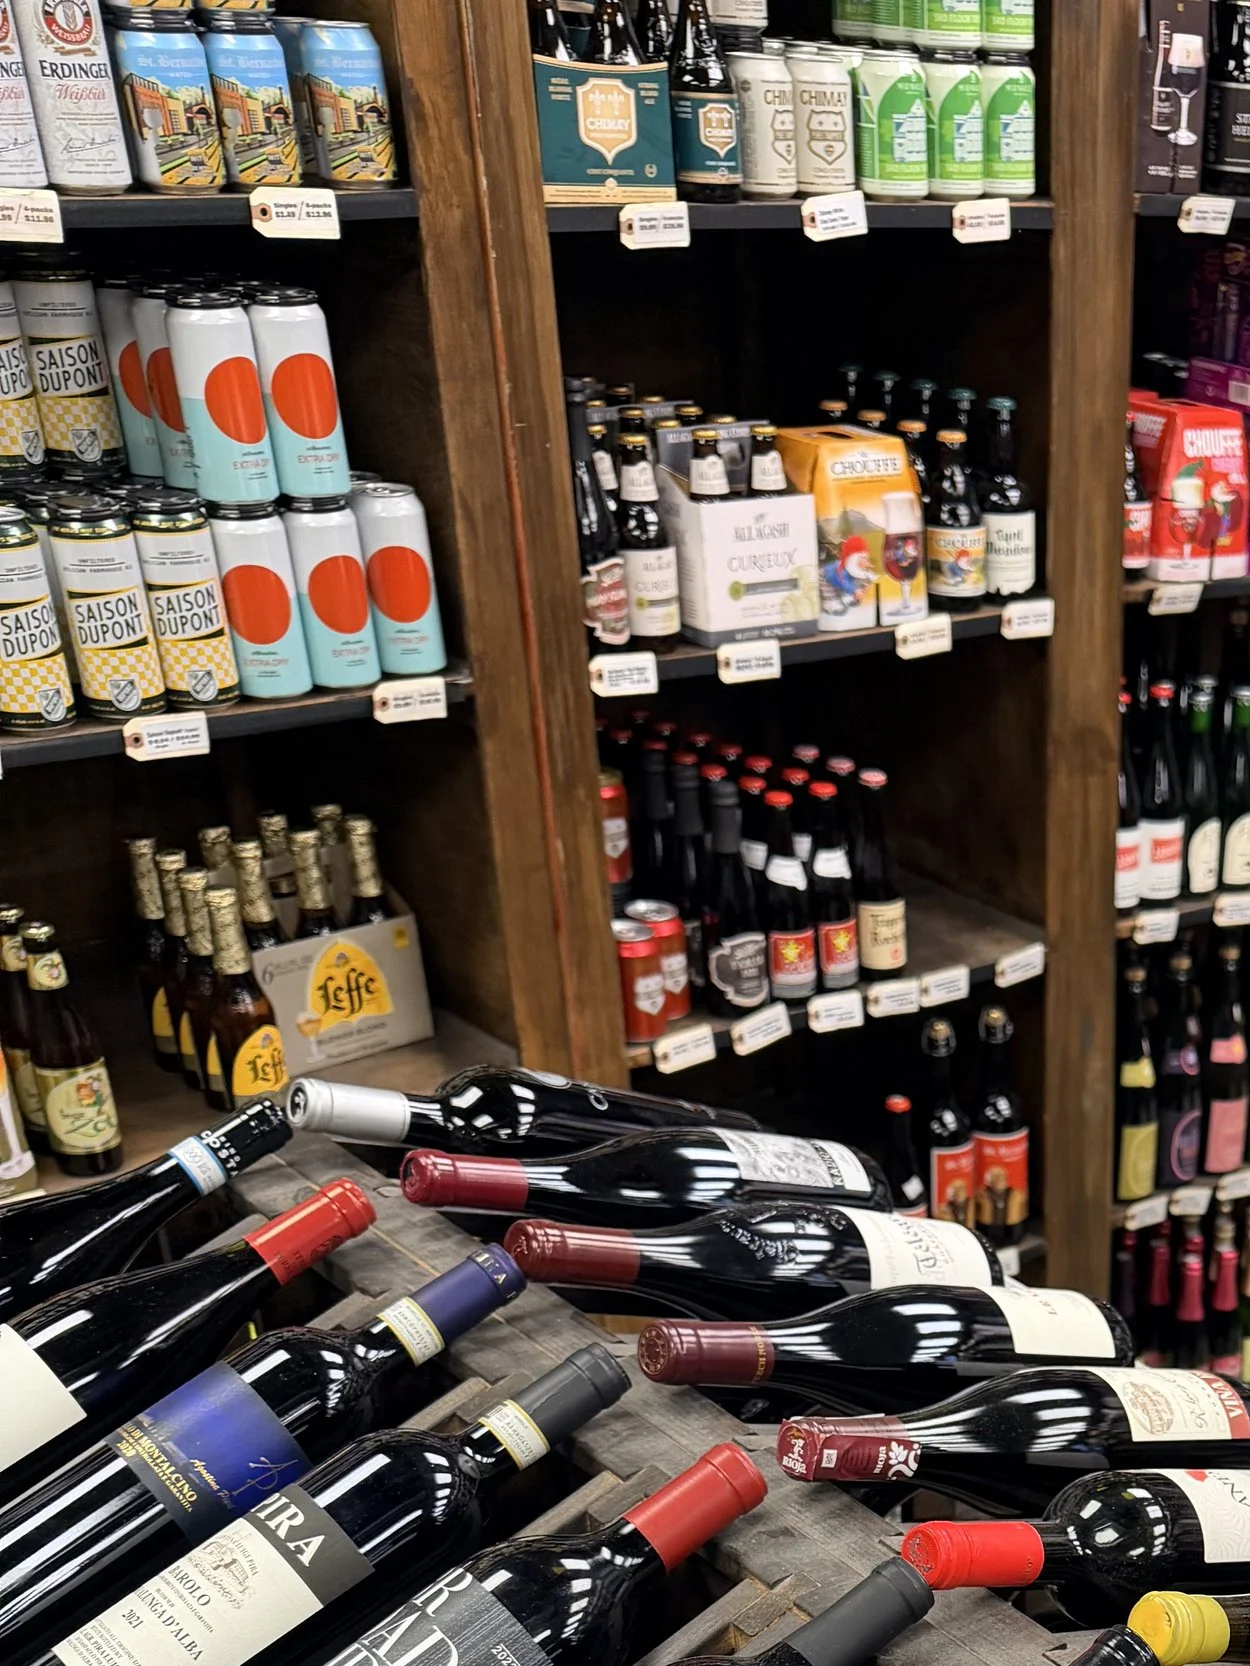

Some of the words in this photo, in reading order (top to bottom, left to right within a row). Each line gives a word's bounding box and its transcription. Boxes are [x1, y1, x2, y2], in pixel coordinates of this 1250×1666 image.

[39, 59, 111, 80] ERDINGER
[586, 118, 631, 130] CHIMAY
[36, 341, 99, 372] SAISON
[39, 363, 105, 395] DUPONT
[1183, 425, 1243, 459] CHOUFFE
[830, 456, 902, 479] CHOUFFE
[76, 593, 138, 625] SAISON
[155, 584, 216, 616] SAISON
[77, 614, 144, 645] DUPONT
[156, 605, 221, 637] DUPONT
[317, 967, 375, 1018] Leffe
[131, 1429, 144, 1439] DI
[141, 1437, 197, 1501] MONTALCINO
[121, 1609, 144, 1629] 2021
[162, 1615, 203, 1661] D'ALBA
